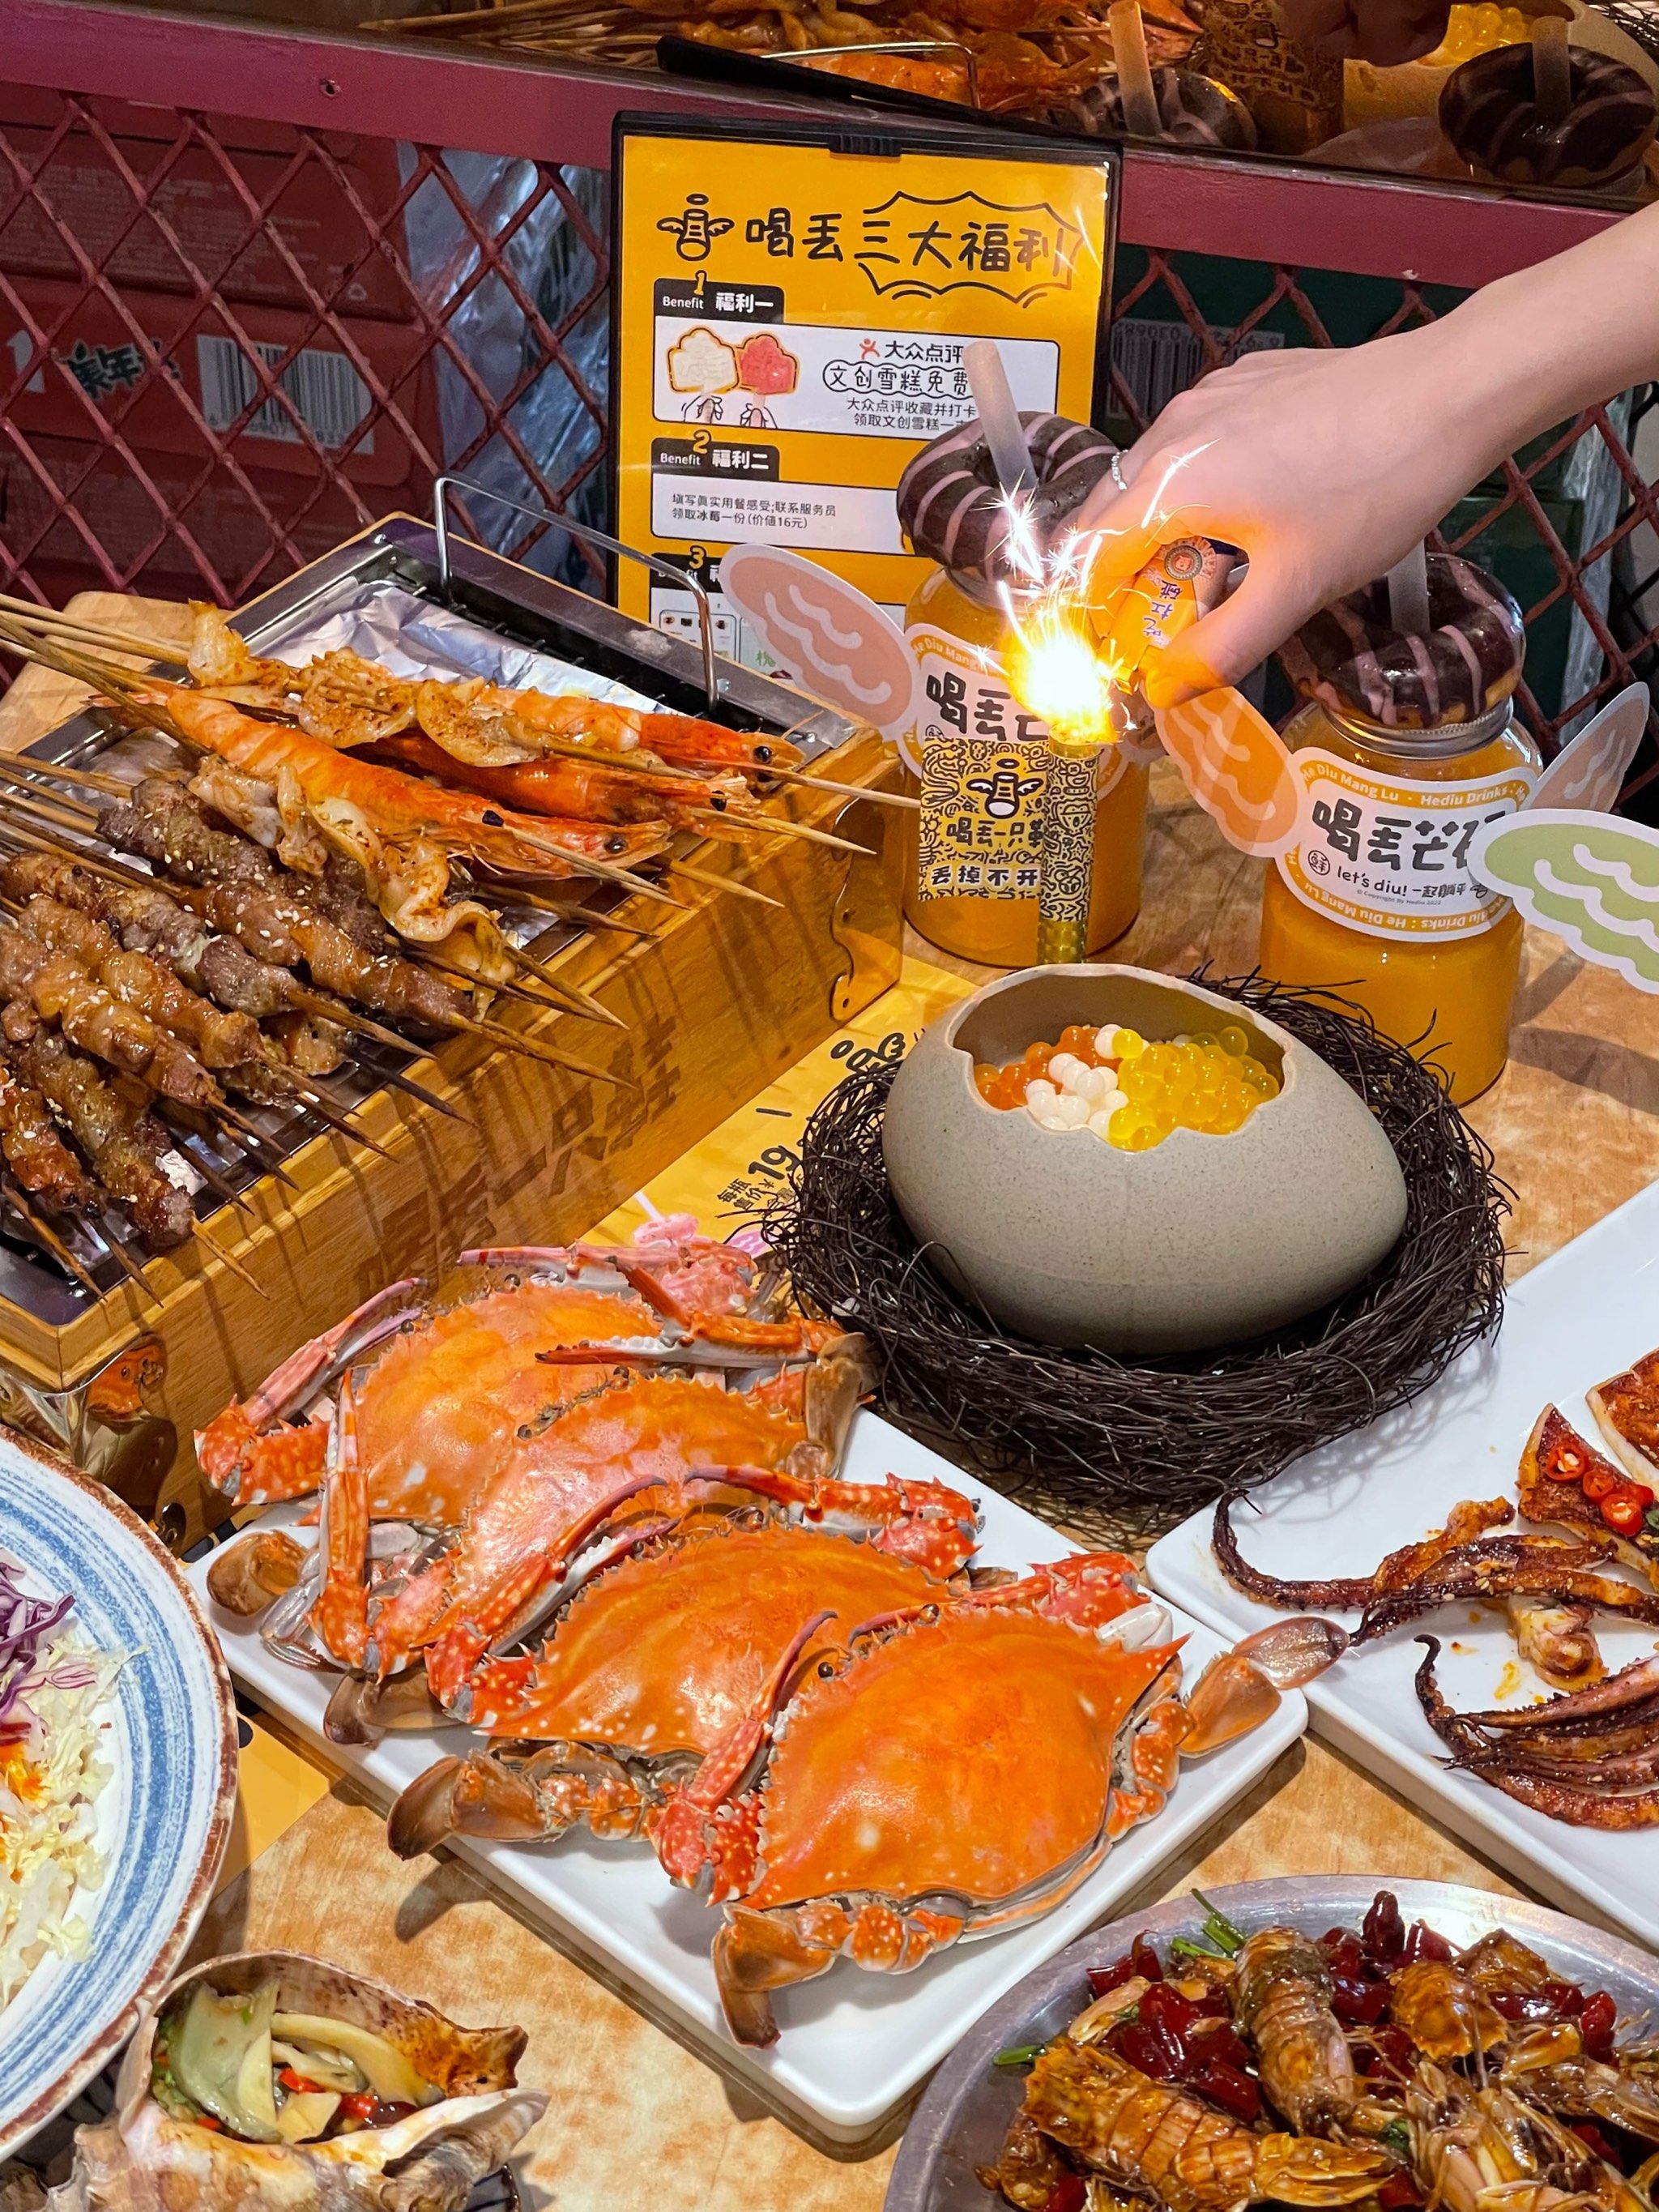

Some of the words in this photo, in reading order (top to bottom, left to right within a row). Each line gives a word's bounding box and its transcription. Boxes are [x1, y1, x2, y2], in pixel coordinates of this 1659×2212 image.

[744, 207, 1064, 278] 喝丢三大福利
[663, 296, 704, 310] Benefit
[715, 293, 774, 314] 福利一
[885, 340, 964, 364] 大众点评
[660, 453, 701, 466] Benefit
[712, 449, 769, 470] 福利二
[1316, 764, 1337, 779] Diu
[1341, 773, 1377, 799] Mang
[1380, 788, 1400, 801] Lu
[1420, 794, 1463, 807] Hediu
[1465, 787, 1508, 805] Drinks
[1337, 866, 1370, 888] let's
[1374, 880, 1407, 896] diu!
[1320, 895, 1358, 918] Mang
[1360, 909, 1384, 925] Diu
[1387, 916, 1406, 928] He
[1422, 917, 1466, 929] Drinks
